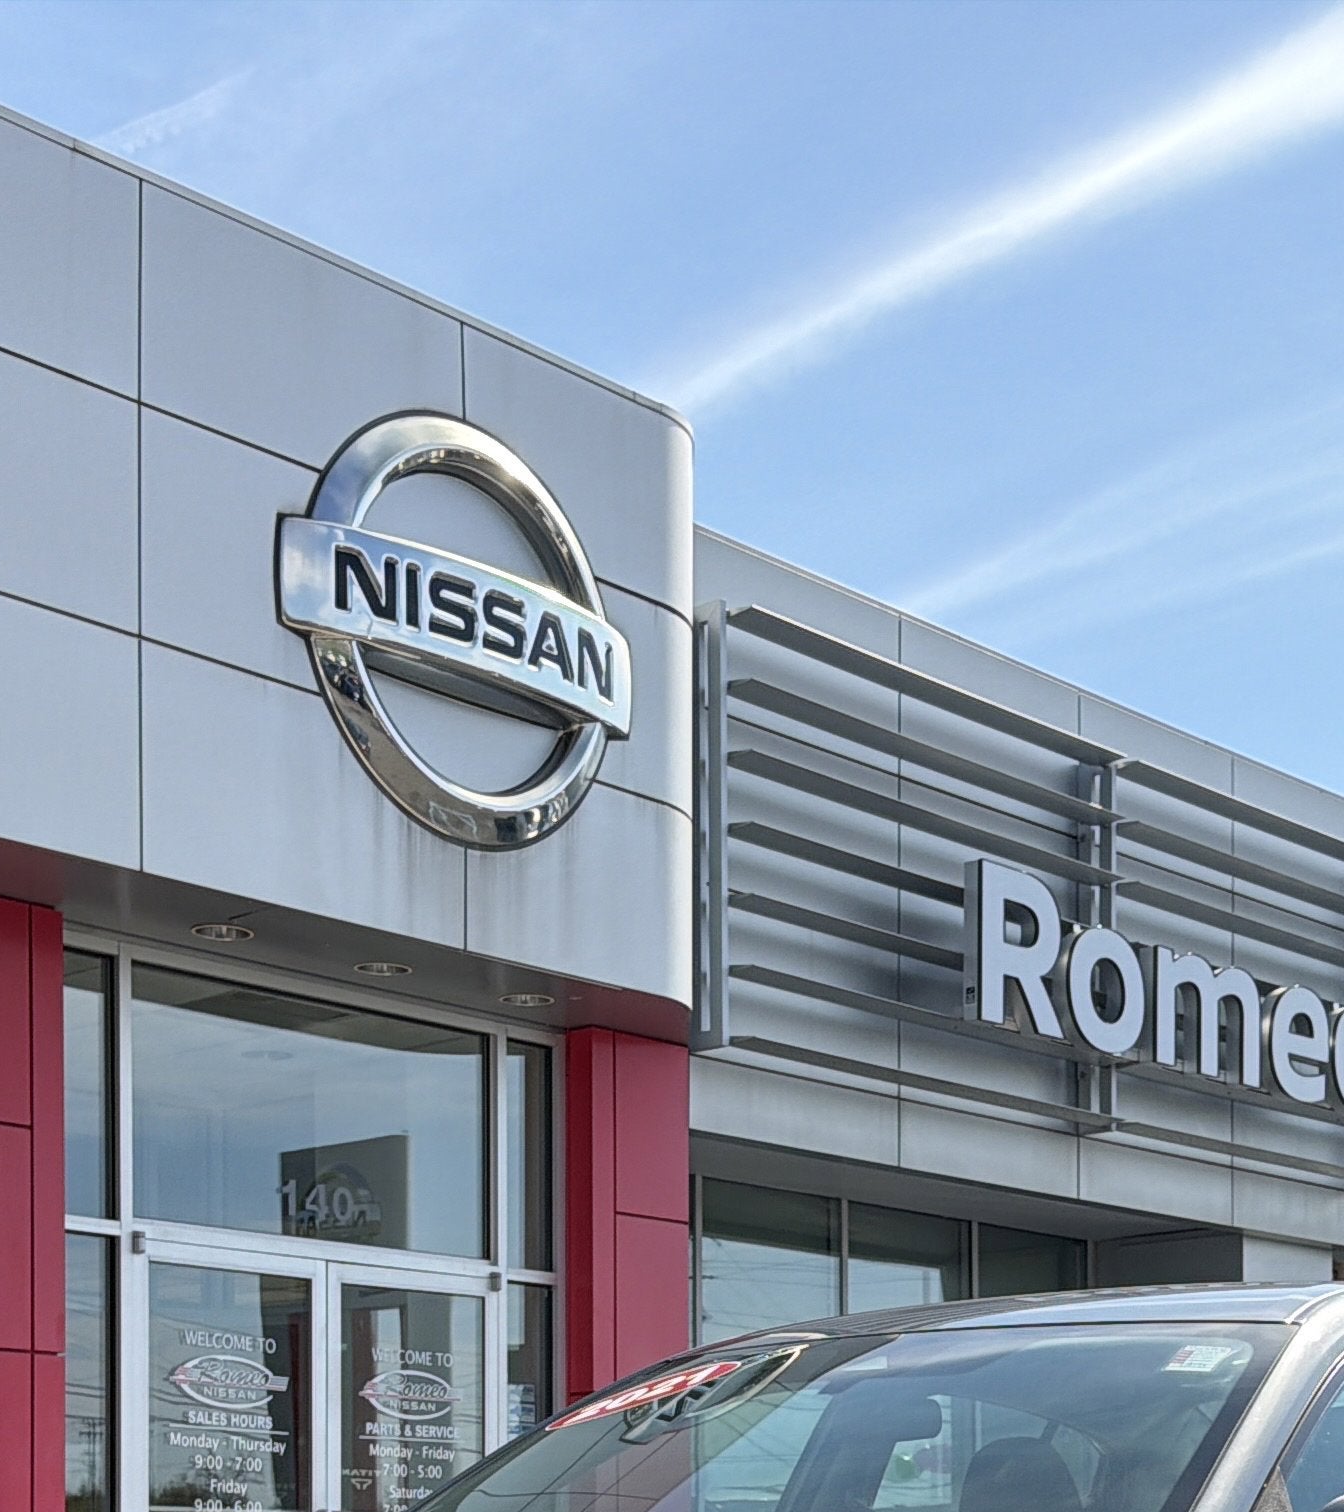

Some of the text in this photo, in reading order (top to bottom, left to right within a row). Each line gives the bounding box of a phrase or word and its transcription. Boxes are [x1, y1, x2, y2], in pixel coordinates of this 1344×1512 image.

[332, 543, 616, 708] NISSAN
[184, 1329, 277, 1354] WELCOME TO
[371, 1347, 454, 1368] WELCOME TO
[196, 1358, 270, 1387] Romeo
[203, 1386, 256, 1400] NISSAN
[384, 1372, 451, 1399] Romeo
[388, 1398, 436, 1411] NISSAN
[188, 1411, 273, 1429] SALES HOURS
[365, 1421, 461, 1439] PARTS & SERVICE
[169, 1432, 220, 1450] Monday
[230, 1436, 287, 1456] Thursday
[368, 1443, 413, 1460] Monday
[422, 1445, 456, 1462] Friday
[194, 1454, 223, 1469] 9:00
[234, 1457, 262, 1472] 7:00
[382, 1463, 408, 1478] 7:00
[417, 1464, 443, 1479] 5:00
[209, 1478, 248, 1496] Friday
[389, 1484, 433, 1499] Saturda
[194, 1498, 223, 1512] 9:00
